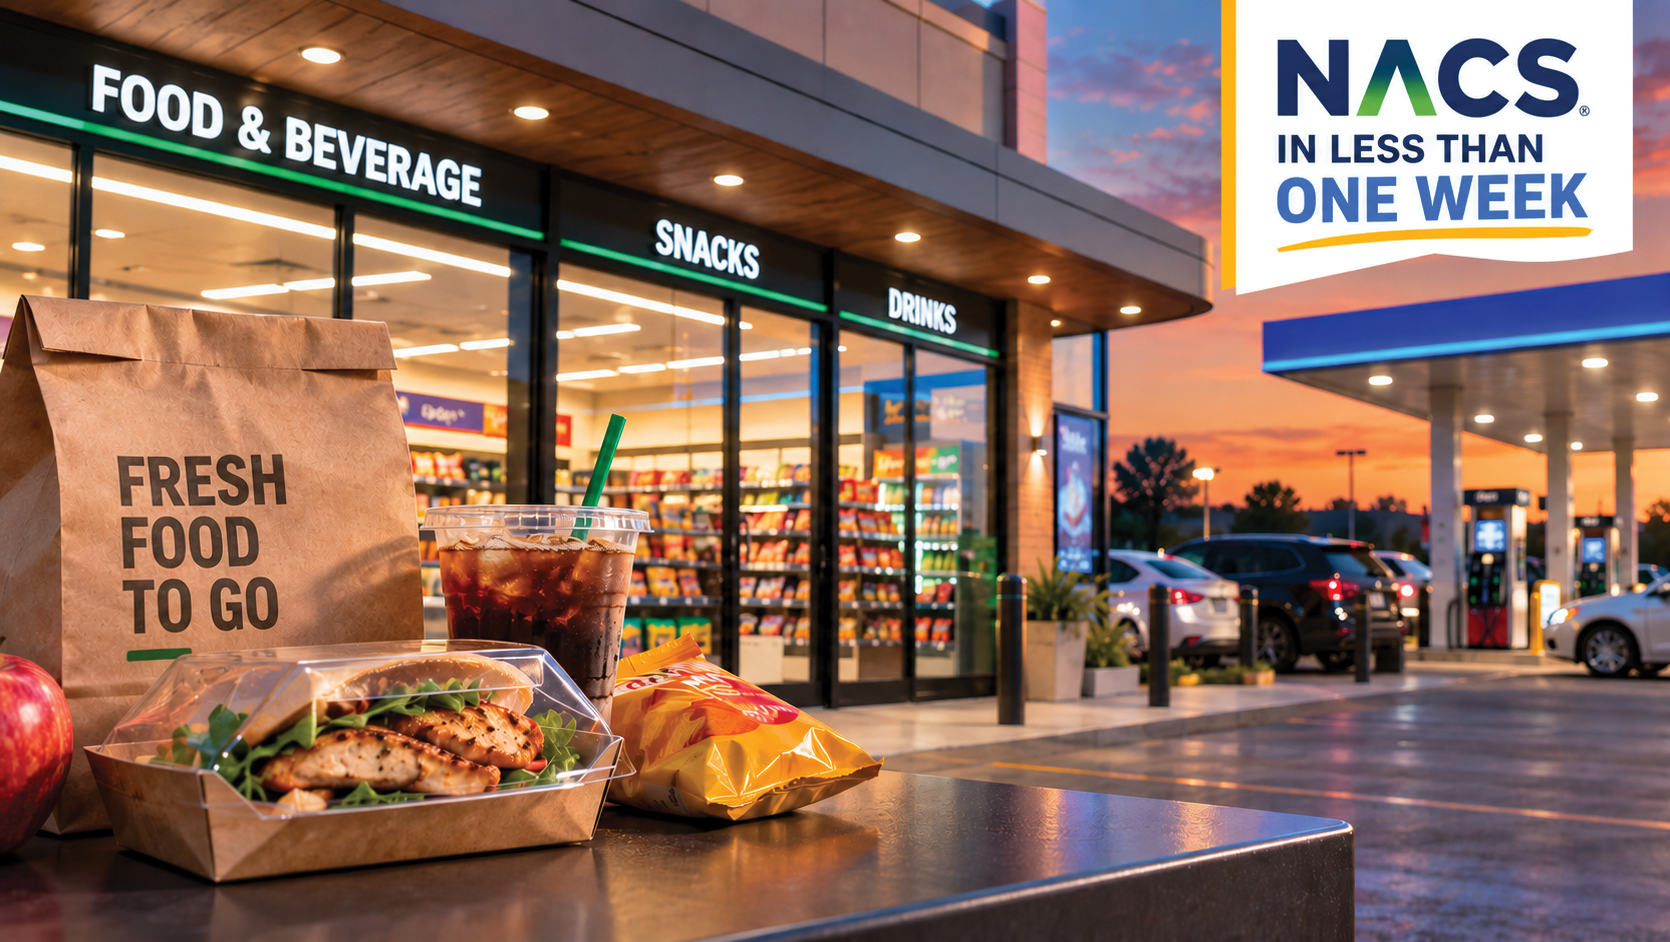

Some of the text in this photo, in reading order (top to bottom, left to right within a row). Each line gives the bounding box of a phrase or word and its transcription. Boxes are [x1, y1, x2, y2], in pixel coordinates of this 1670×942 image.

[92, 64, 483, 208] FOOD & BEVERAGE
[655, 218, 760, 279] SNACKS
[888, 287, 957, 335] DRINKS
[117, 454, 287, 507] FRESH
[121, 516, 259, 569] FOOD
[122, 576, 279, 634] TO GO
